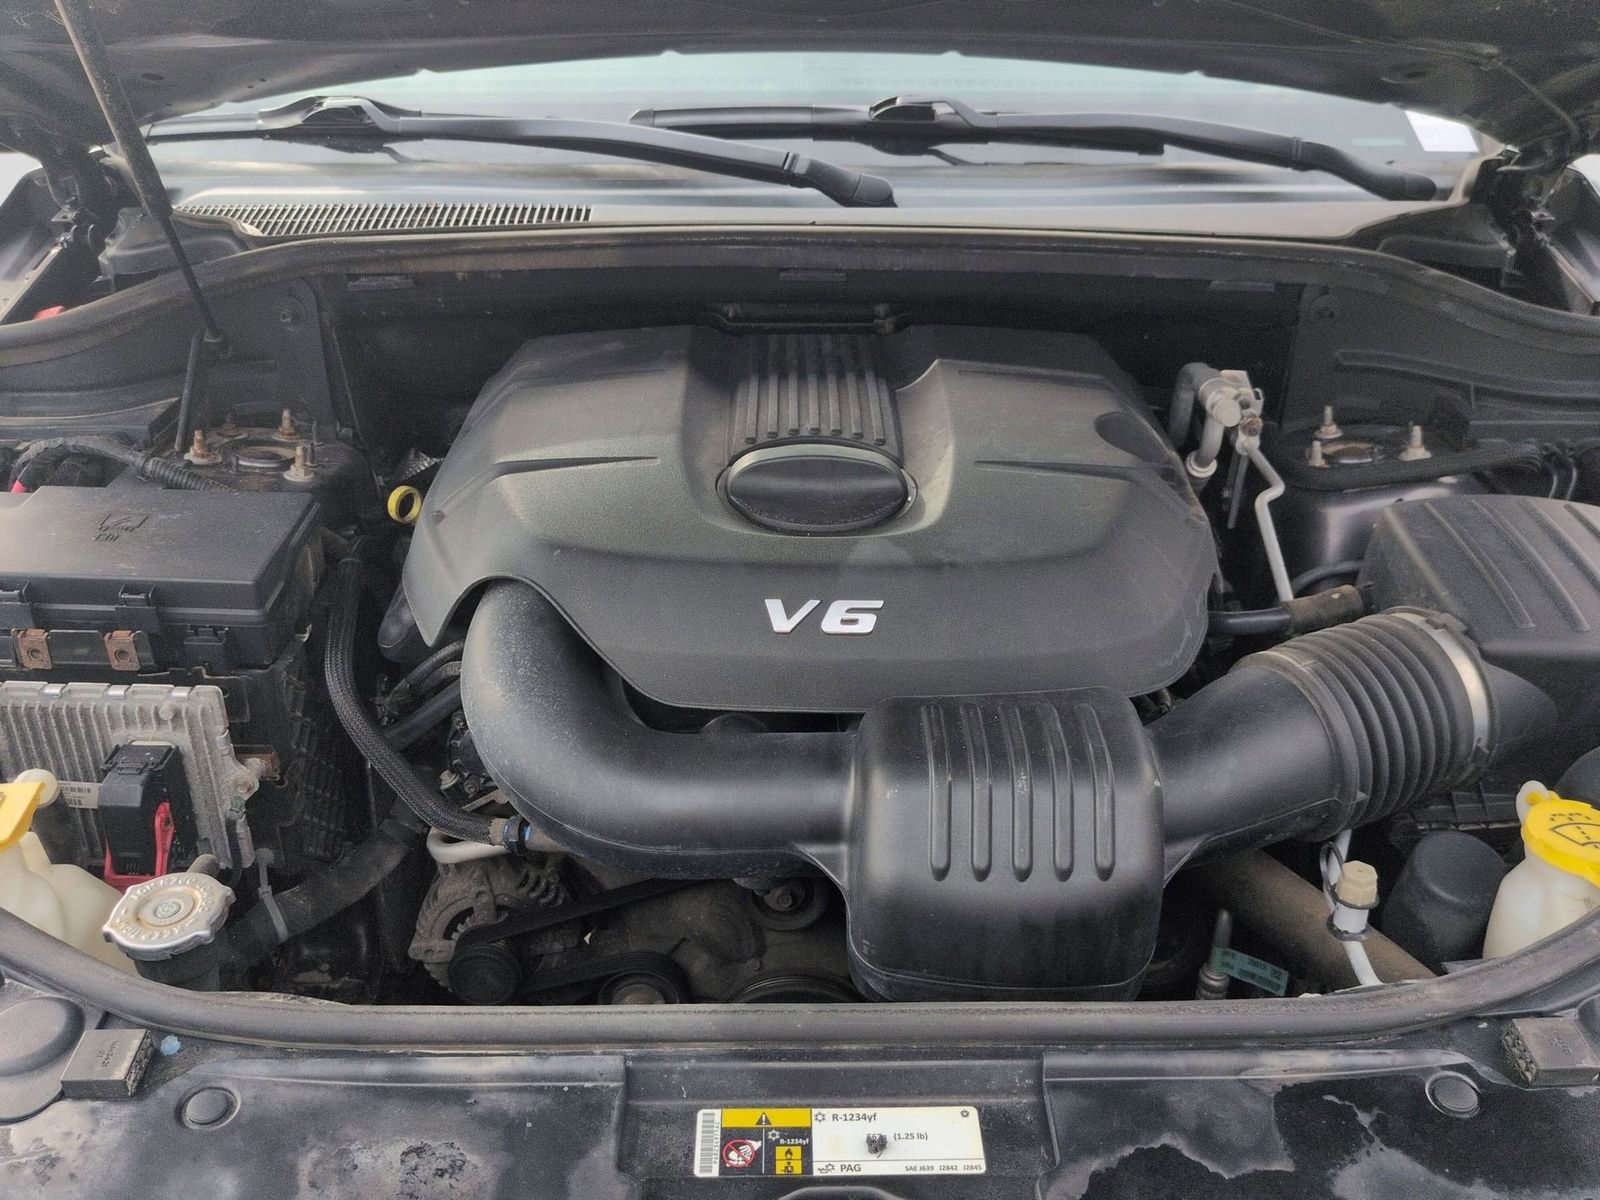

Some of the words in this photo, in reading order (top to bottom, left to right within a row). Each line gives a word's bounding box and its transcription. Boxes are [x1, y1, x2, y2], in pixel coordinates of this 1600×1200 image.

[764, 598, 885, 634] V6
[832, 1112, 877, 1123] R-1234yf
[893, 1132, 914, 1141] (1.25
[916, 1132, 929, 1141] lb)
[840, 1163, 862, 1173] PAG
